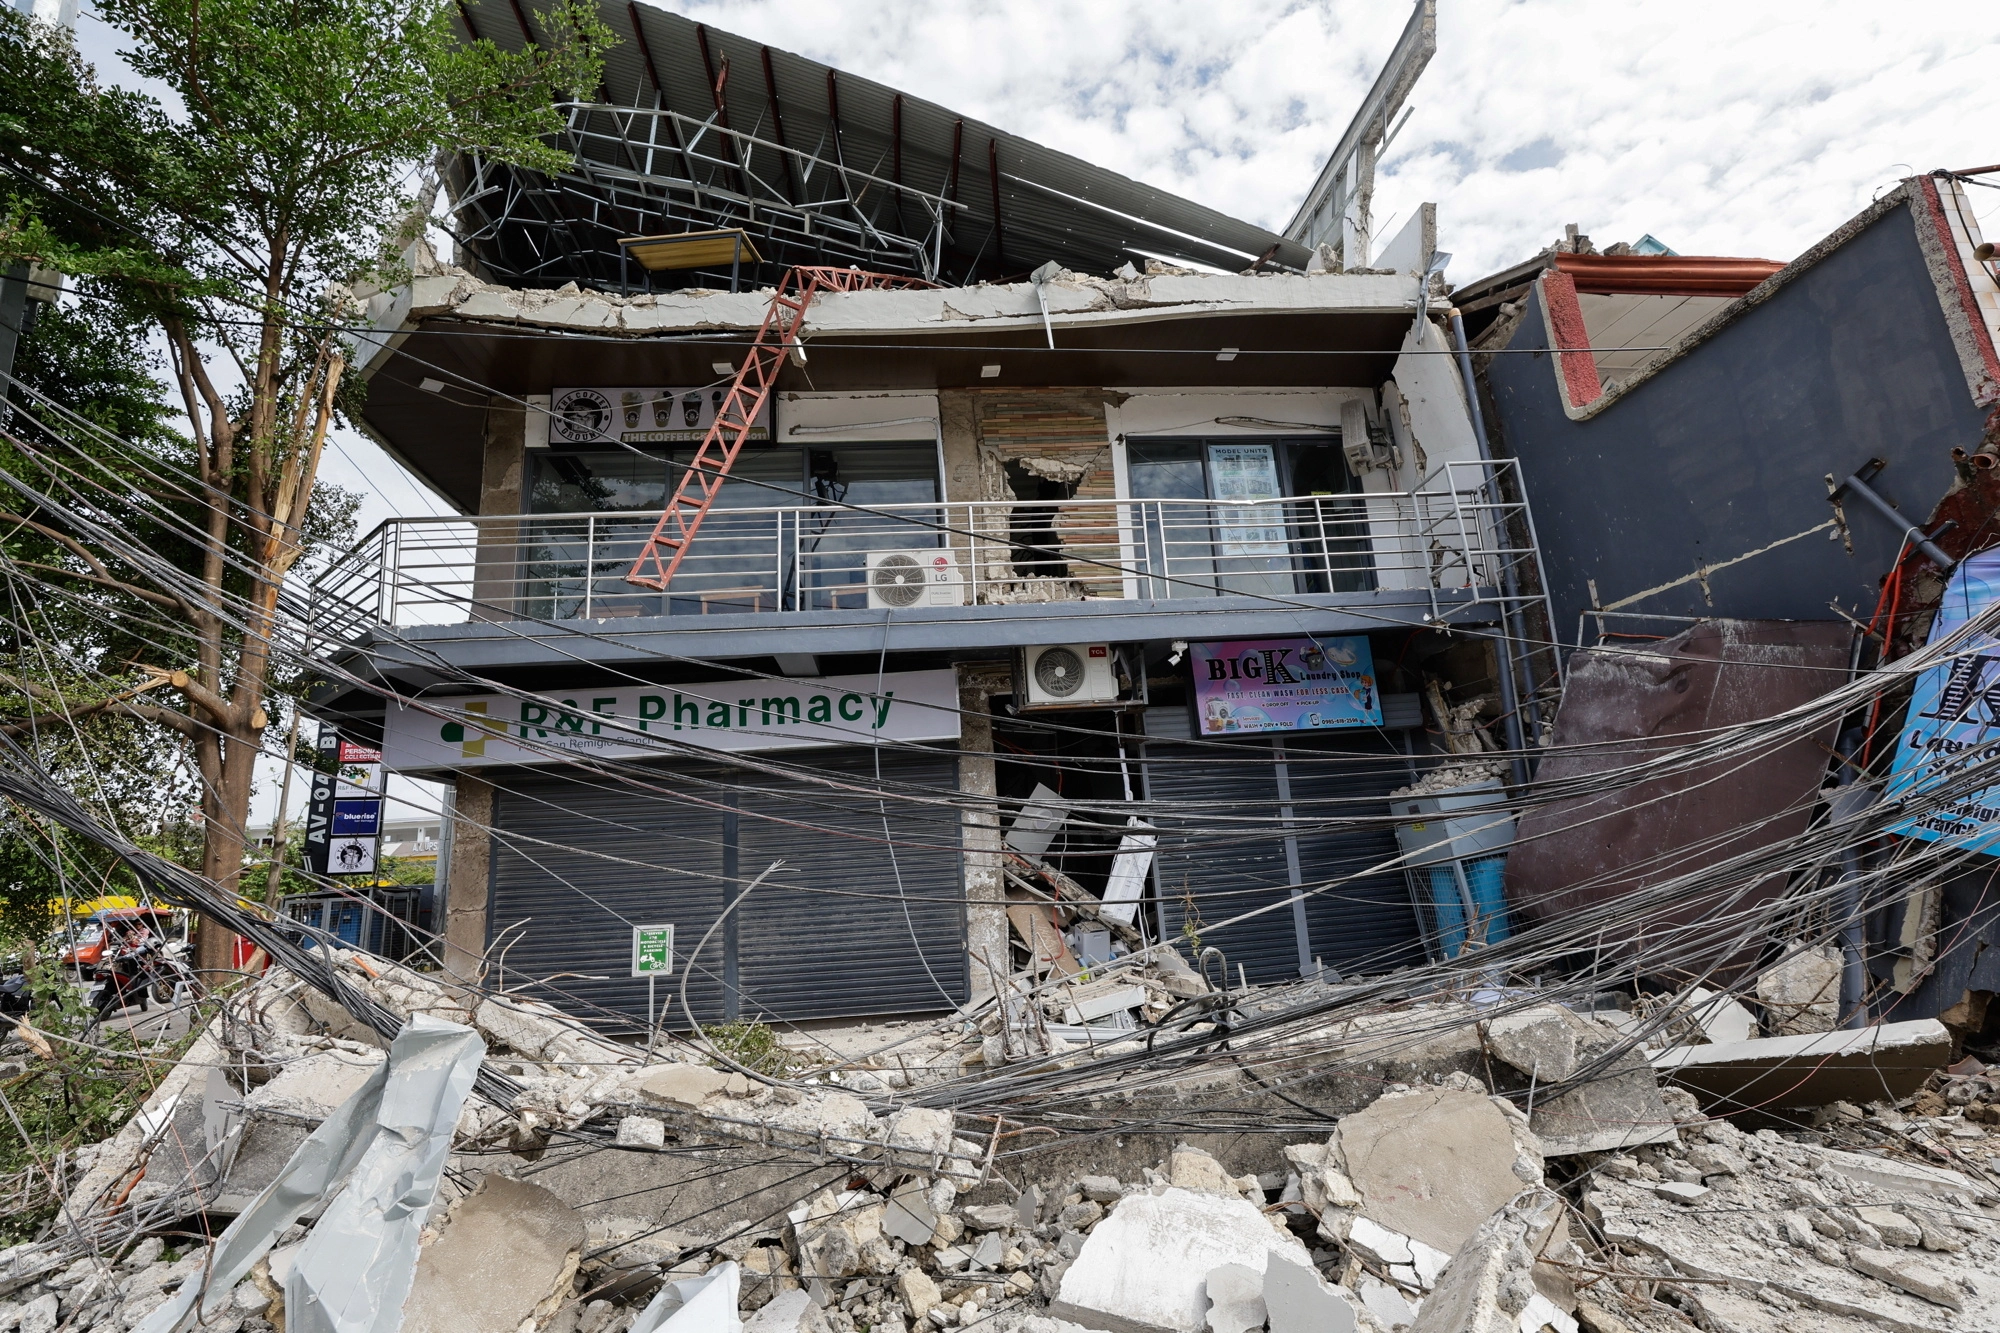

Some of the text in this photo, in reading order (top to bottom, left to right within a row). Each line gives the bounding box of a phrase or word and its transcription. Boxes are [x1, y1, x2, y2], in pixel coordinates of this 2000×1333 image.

[557, 391, 608, 411] THE COFFEE
[623, 433, 647, 442] THE
[647, 432, 691, 442] COFFEE
[935, 574, 948, 582] LG
[1300, 670, 1361, 681] Laundry Shop
[1249, 690, 1271, 699] CLEAN
[1273, 689, 1294, 697] WASH
[1296, 688, 1309, 696] FOR
[1312, 687, 1328, 695] LESS
[1331, 686, 1350, 694] CASH
[520, 691, 894, 739] R&F Pharmacy
[546, 740, 566, 749] San
[569, 739, 614, 750] Remigio
